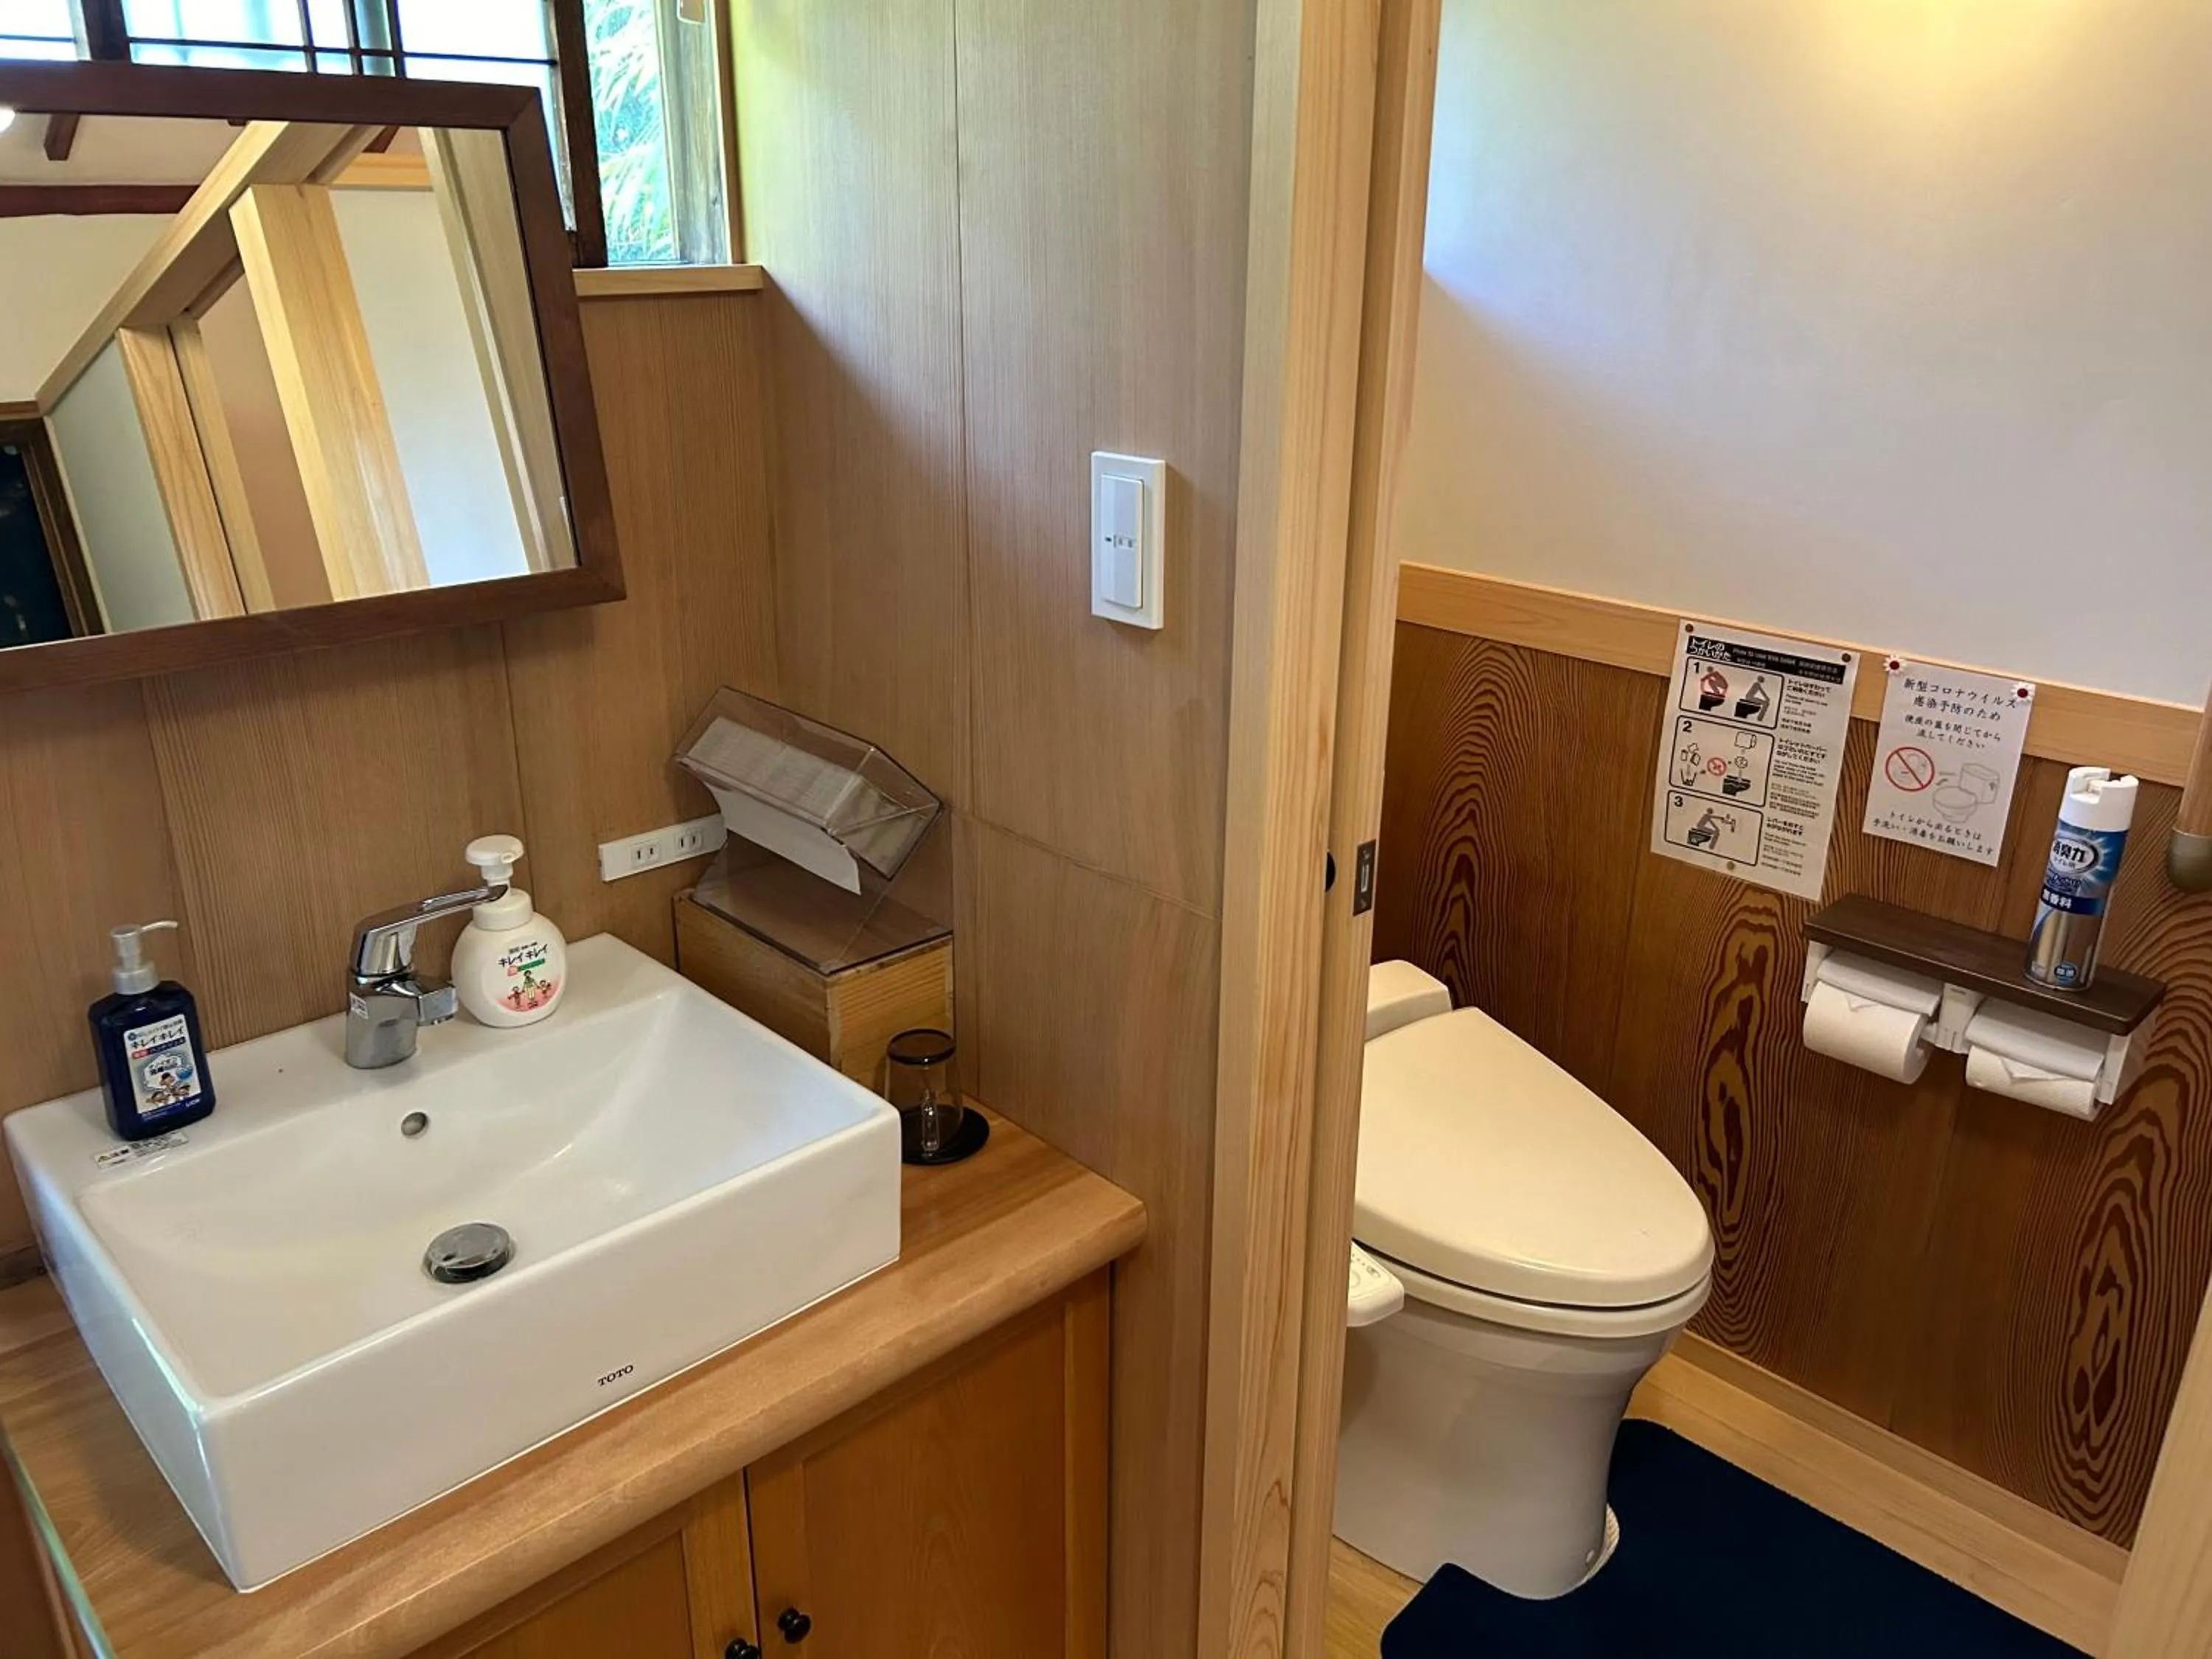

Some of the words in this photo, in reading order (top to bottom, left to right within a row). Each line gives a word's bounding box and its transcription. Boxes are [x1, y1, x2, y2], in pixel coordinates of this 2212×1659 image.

[1691, 637, 1725, 651] トイレの
[1693, 662, 1700, 674] 1
[1904, 678, 2016, 709] 新型コロナウイルス
[1913, 695, 2000, 721] 感染予防のため
[1683, 720, 1691, 732] 2
[1916, 730, 1985, 749] 流してください
[1674, 796, 1683, 807] 3
[129, 1026, 184, 1048] キレイキレイ
[597, 1365, 633, 1386] TOTO
